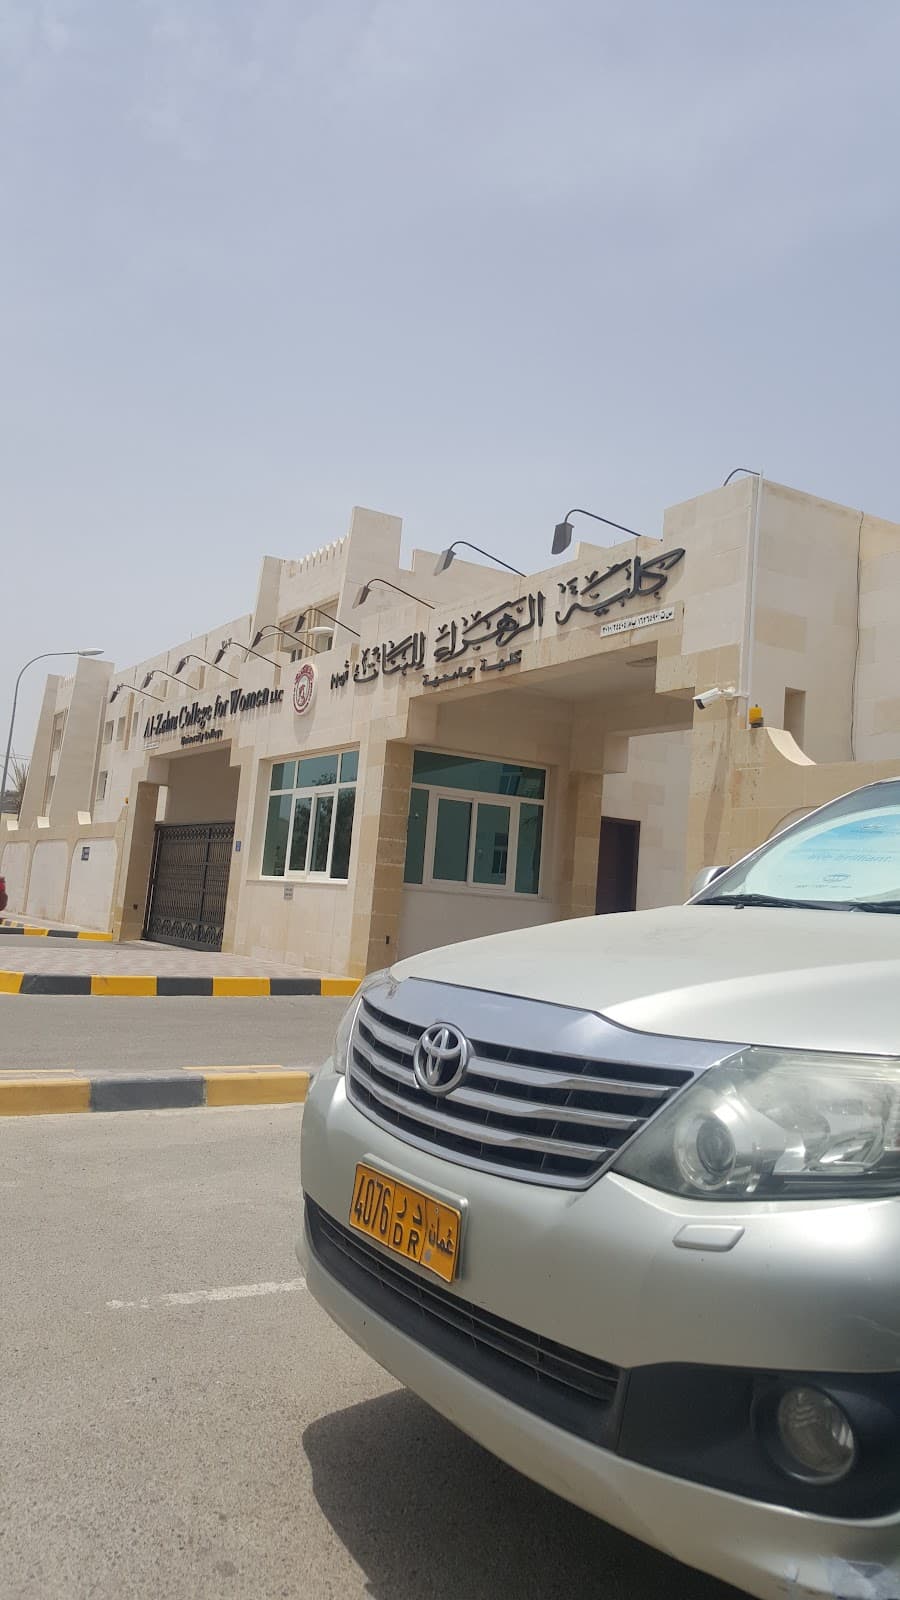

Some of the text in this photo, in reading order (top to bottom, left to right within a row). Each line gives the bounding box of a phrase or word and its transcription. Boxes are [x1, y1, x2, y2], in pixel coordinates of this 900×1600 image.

[555, 548, 686, 625] كلية
[353, 631, 426, 683] للبنات
[422, 650, 522, 687] كلية جامعية
[179, 701, 212, 729] College
[213, 694, 229, 719] for
[230, 688, 270, 714] Women
[354, 1175, 391, 1235] 4076
